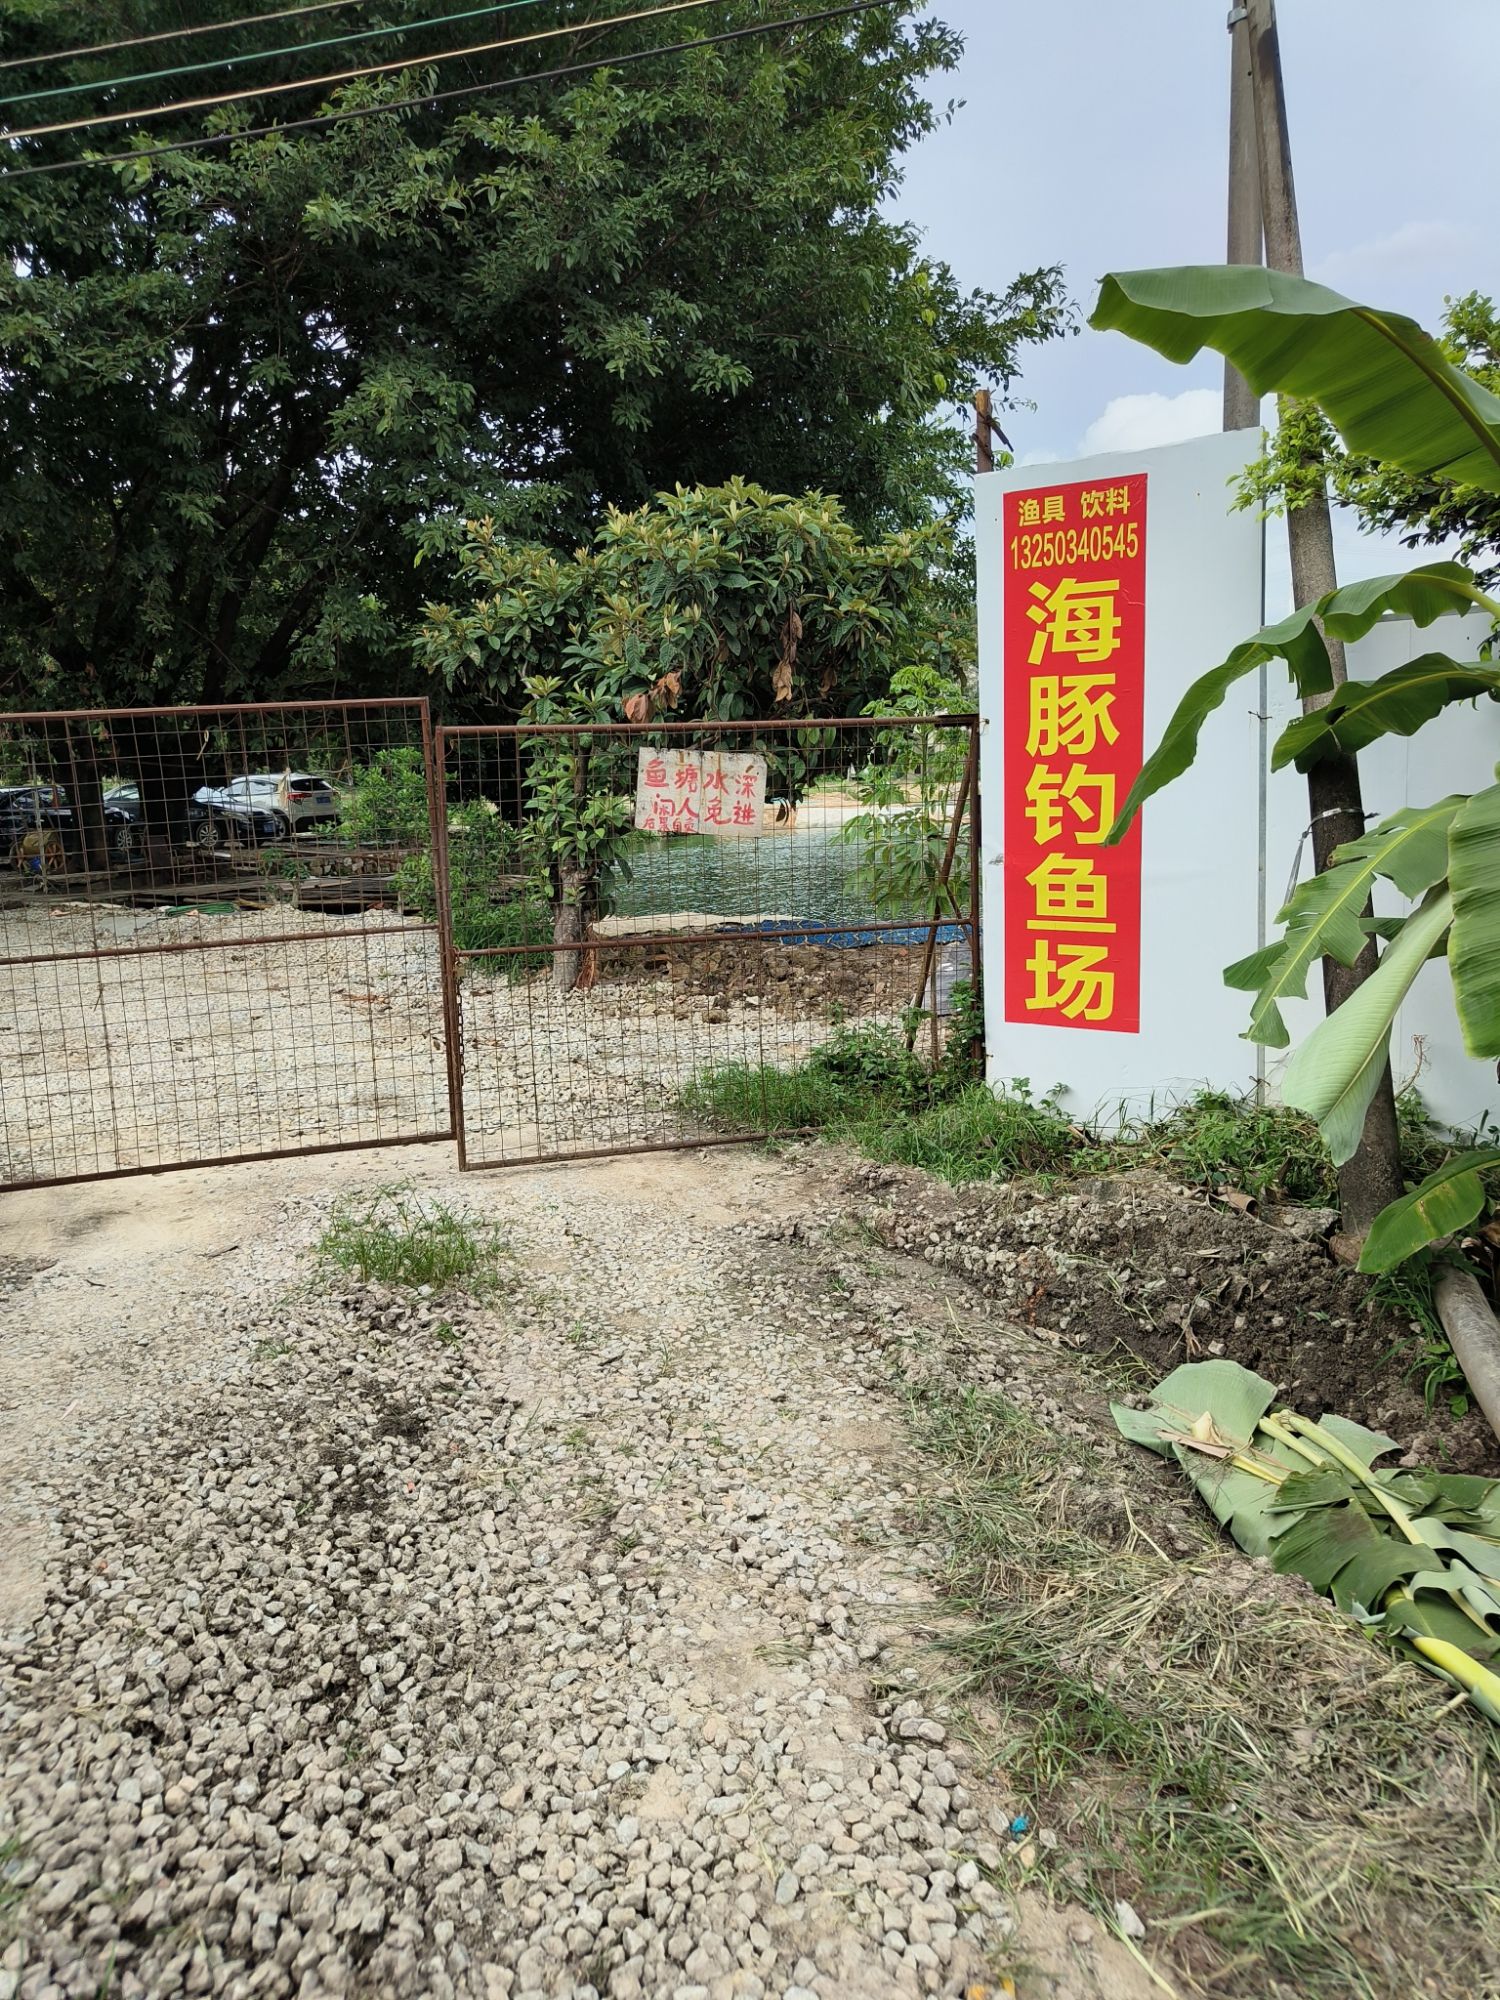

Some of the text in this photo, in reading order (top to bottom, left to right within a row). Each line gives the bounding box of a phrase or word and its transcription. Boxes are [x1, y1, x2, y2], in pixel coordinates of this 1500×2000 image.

[1018, 485, 1131, 527] 渔具 饮料
[1010, 522, 1139, 570] 13250340545
[644, 758, 757, 798] 鱼塘水深
[1025, 578, 1121, 1020] 海豚钓鱼场
[653, 793, 756, 825] 闲人免进
